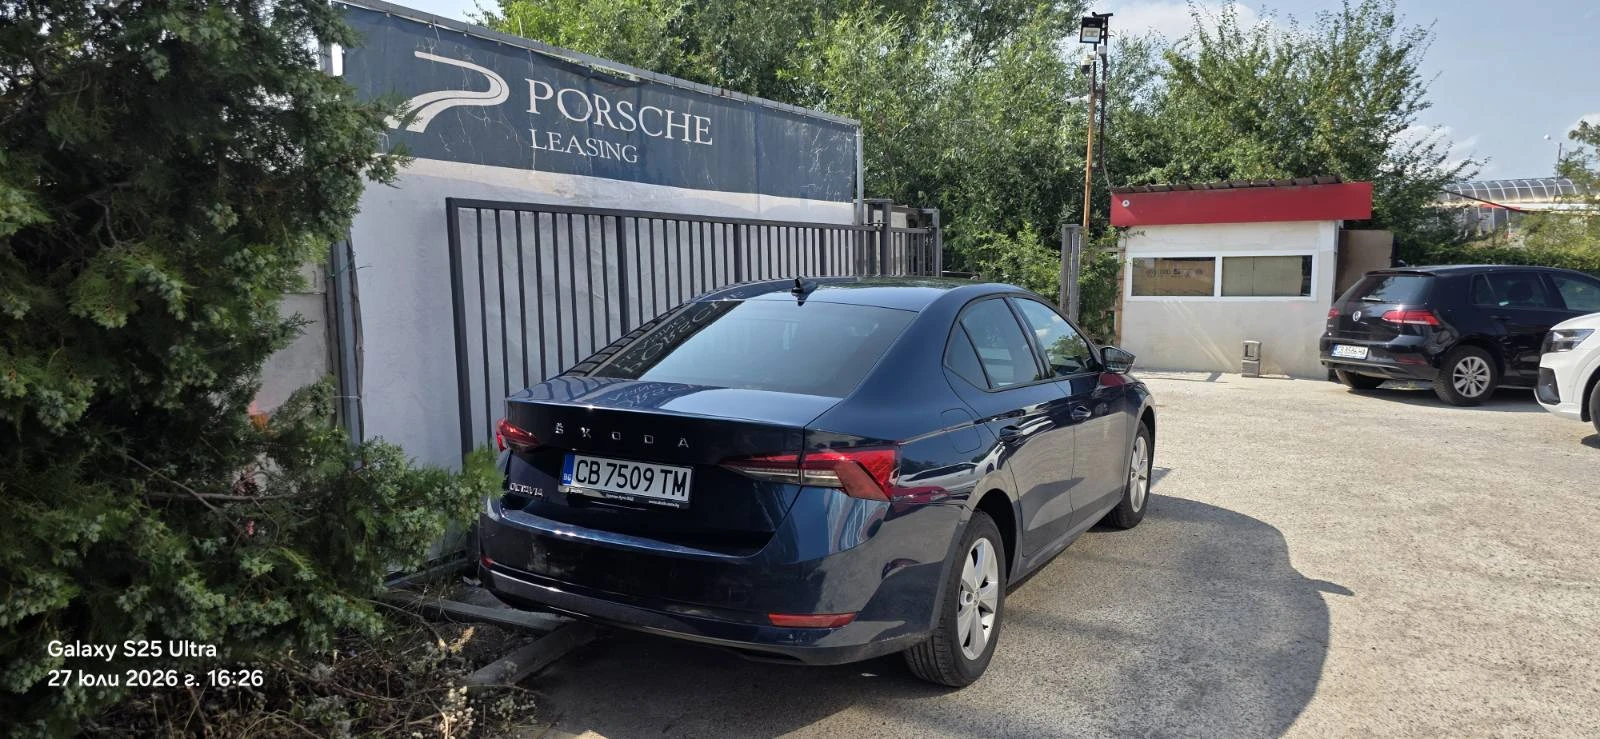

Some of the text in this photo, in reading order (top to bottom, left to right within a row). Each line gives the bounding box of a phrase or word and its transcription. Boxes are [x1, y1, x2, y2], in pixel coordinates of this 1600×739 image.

[524, 78, 713, 146] PORSCHE
[529, 129, 638, 164] LEASING
[509, 482, 544, 497] OCTAVIA
[575, 459, 688, 497] CB 7509 TM
